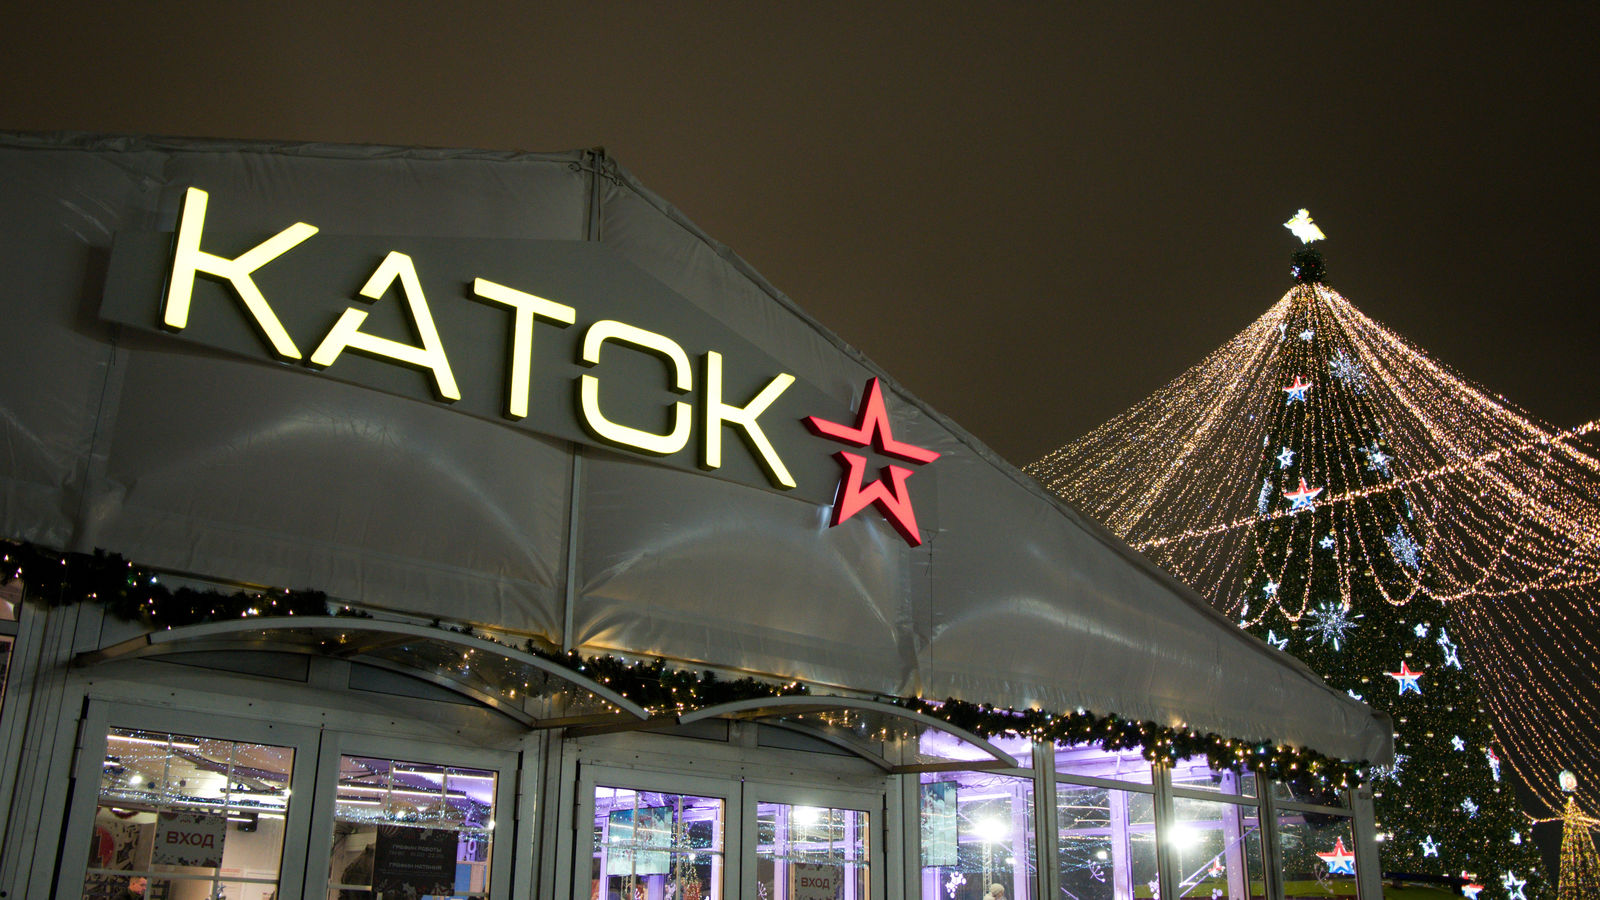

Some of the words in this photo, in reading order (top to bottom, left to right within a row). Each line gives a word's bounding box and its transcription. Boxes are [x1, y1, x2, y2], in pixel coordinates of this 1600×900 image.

[162, 186, 797, 489] КАТОК
[166, 831, 215, 849] ВХОД
[801, 877, 830, 889] ВХОД
